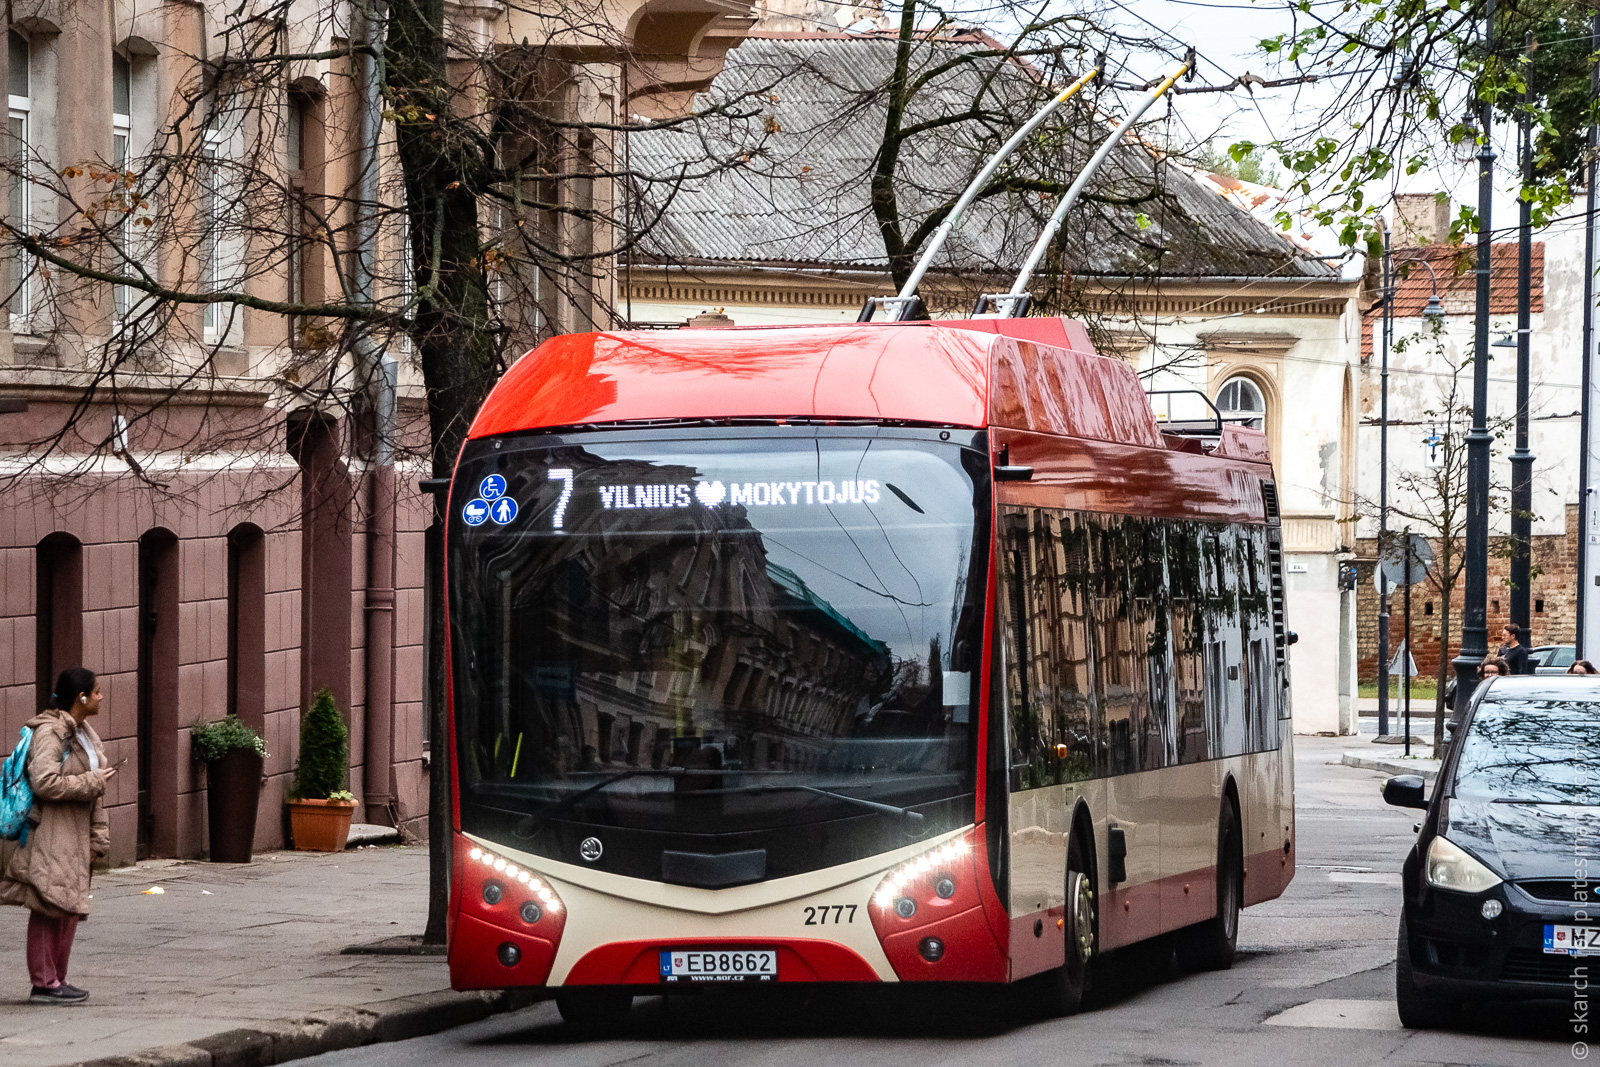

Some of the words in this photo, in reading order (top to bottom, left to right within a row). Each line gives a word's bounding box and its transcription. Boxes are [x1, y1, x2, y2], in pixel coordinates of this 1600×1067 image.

[548, 468, 574, 528] 7
[599, 484, 691, 509] VILNIUS
[730, 479, 880, 506] MOKYTOJUS
[803, 904, 858, 926] 2777
[687, 953, 771, 972] EB8662
